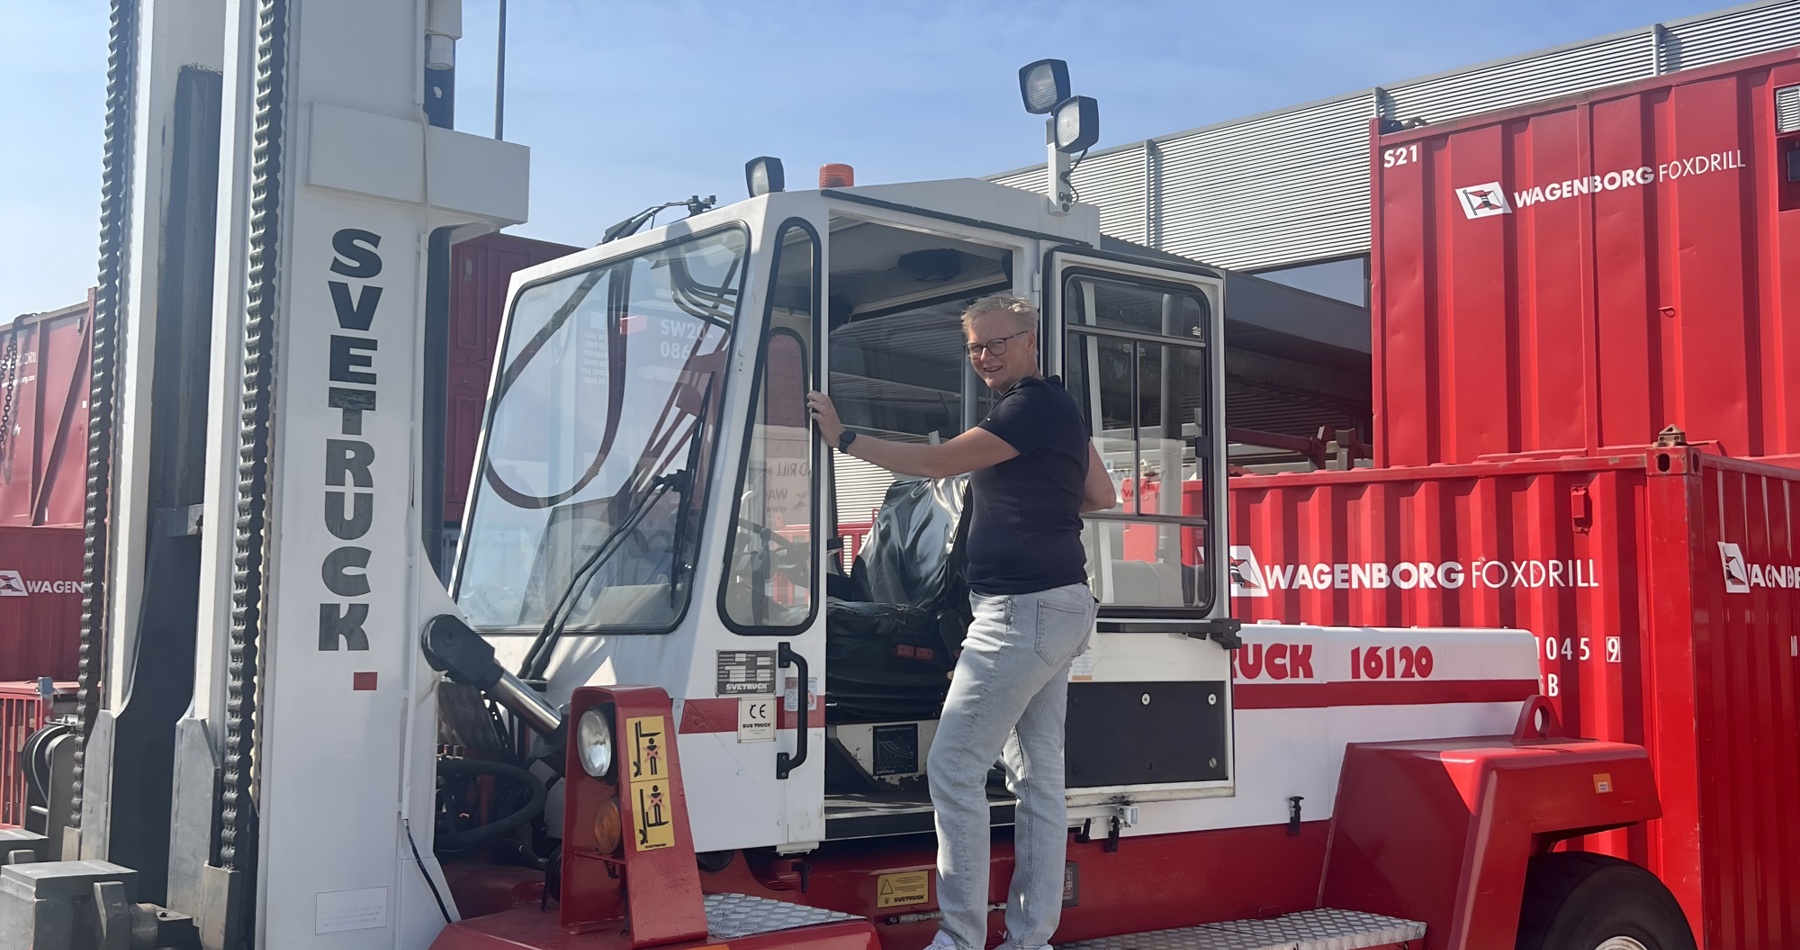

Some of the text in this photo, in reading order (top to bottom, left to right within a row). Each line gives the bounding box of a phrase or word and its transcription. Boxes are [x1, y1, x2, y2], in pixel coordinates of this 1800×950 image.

[1383, 145, 1418, 168] S21
[1513, 150, 1746, 208] WAGENBORG FOXDRILL
[318, 228, 384, 652] SVETRUCK
[1265, 559, 1599, 590] WAGENBORG FOXDRILL
[1233, 643, 1434, 680] UCK 16120
[1607, 637, 1619, 661] 9
[749, 704, 766, 719] CE
